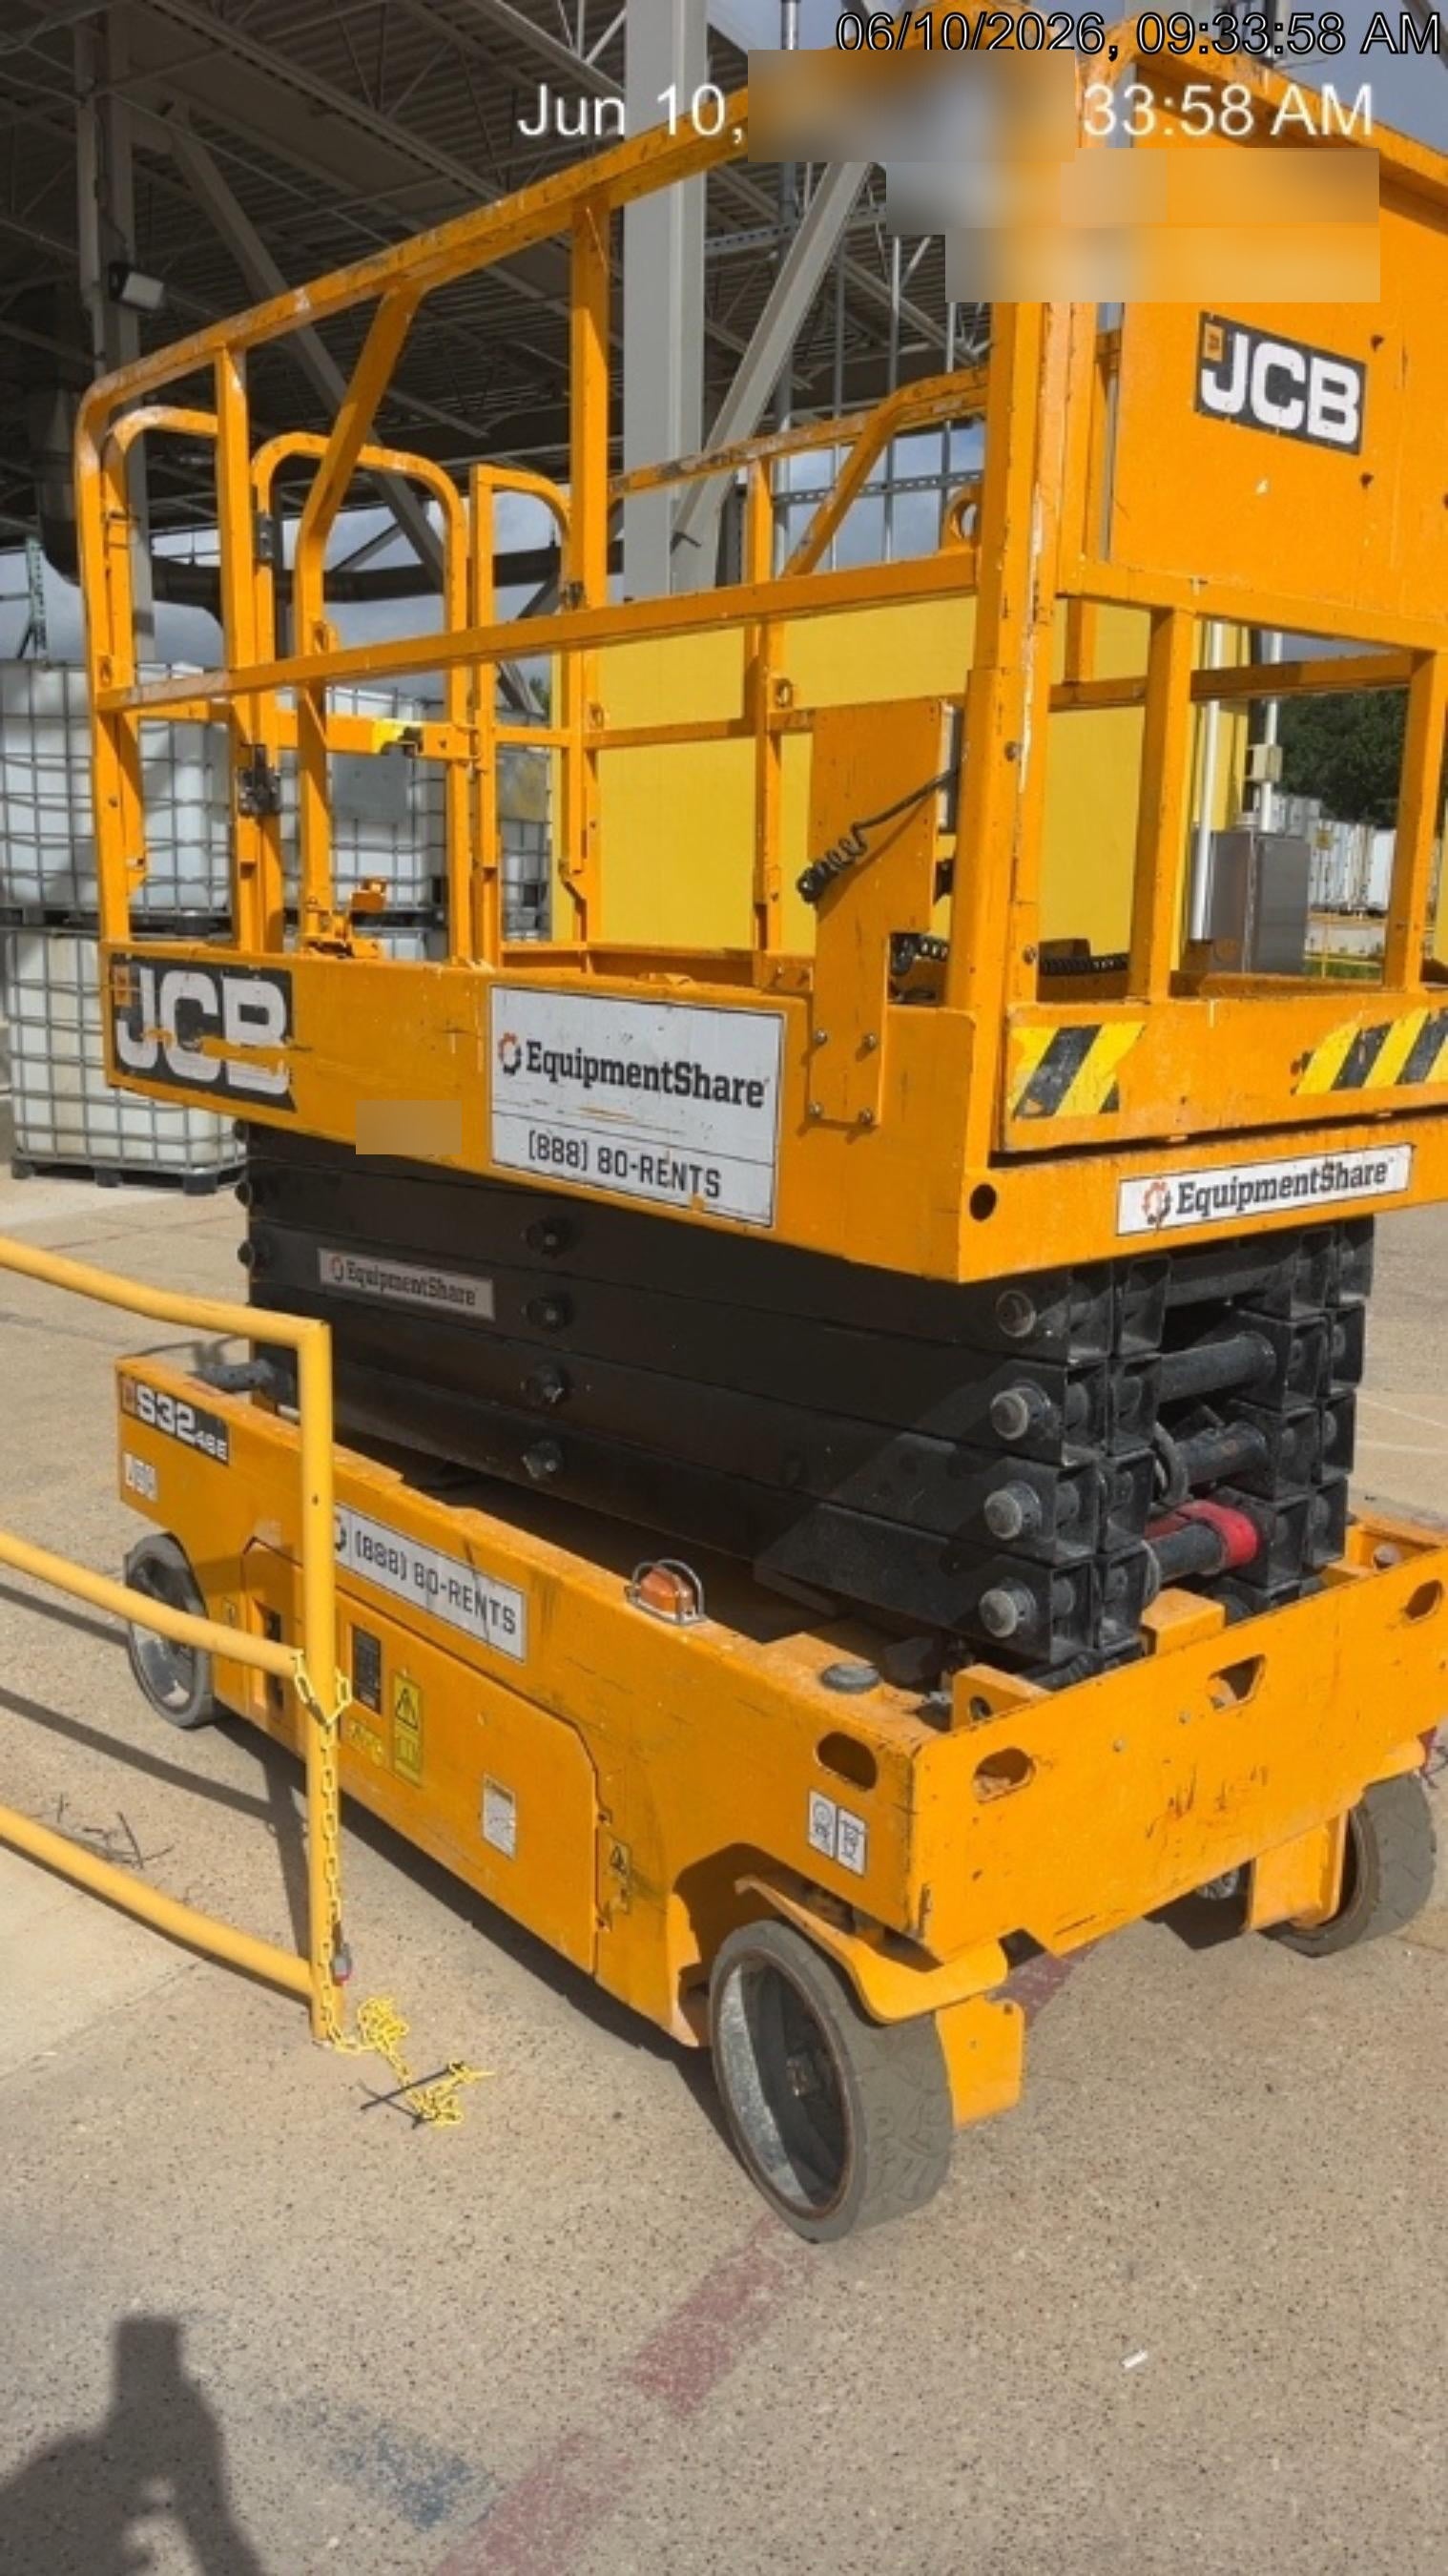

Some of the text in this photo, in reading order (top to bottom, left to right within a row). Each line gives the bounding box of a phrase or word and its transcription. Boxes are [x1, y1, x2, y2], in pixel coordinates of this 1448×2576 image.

[1201, 331, 1361, 445] JCB
[115, 965, 290, 1095] JCB
[526, 1040, 766, 1109] EquipmentShare
[527, 1130, 721, 1199] (888) 80-RENTS
[1175, 1160, 1388, 1218] EquipmentShare
[345, 1259, 476, 1306] EquipmentShare
[354, 1529, 516, 1635] (888) 80-RENTS
